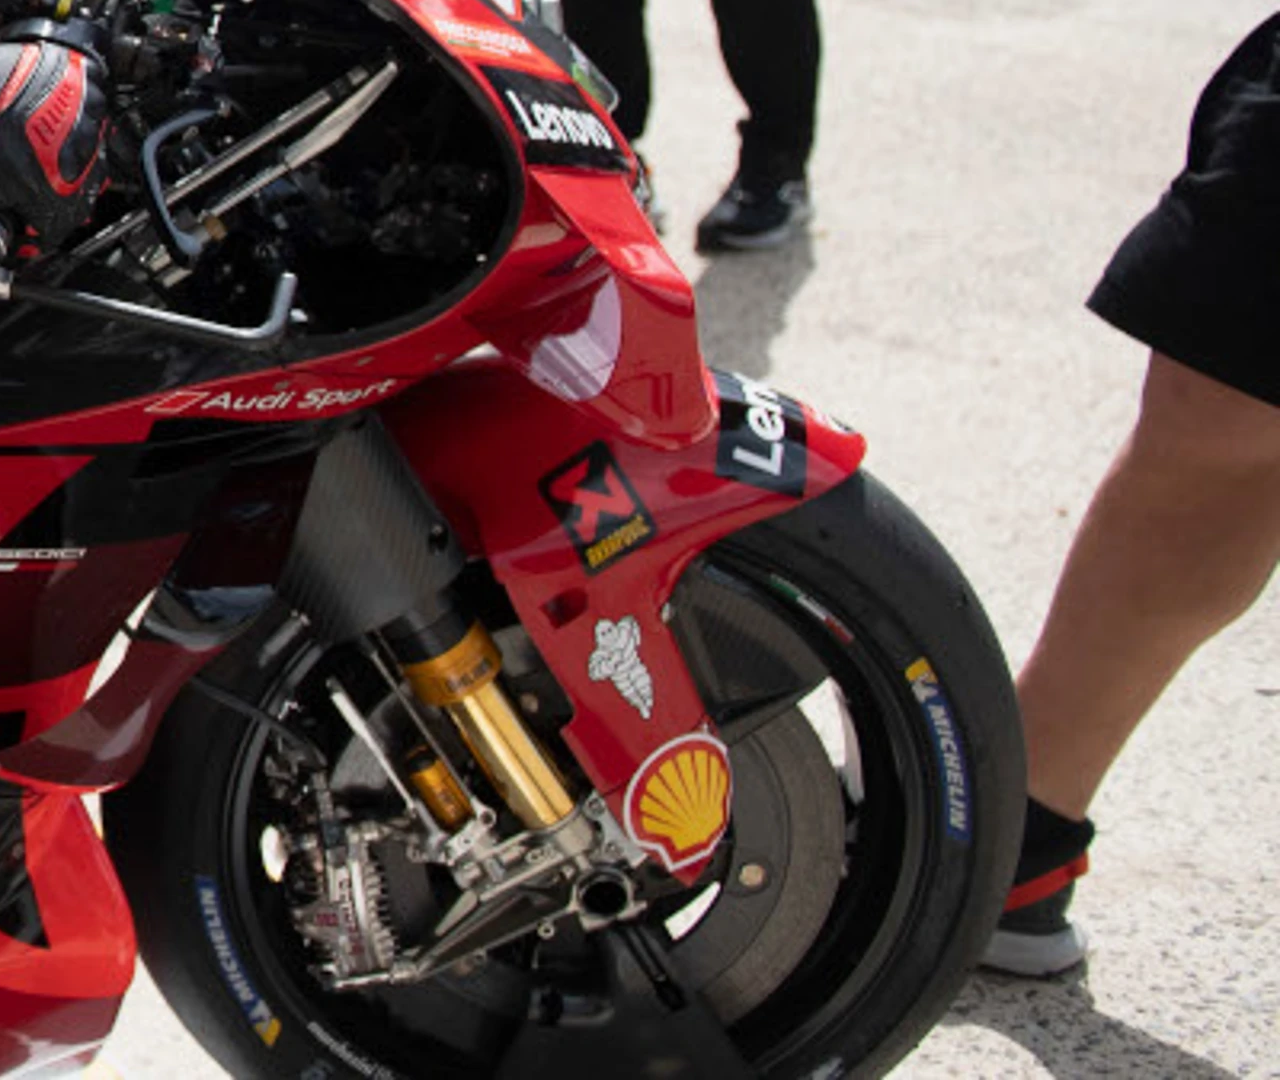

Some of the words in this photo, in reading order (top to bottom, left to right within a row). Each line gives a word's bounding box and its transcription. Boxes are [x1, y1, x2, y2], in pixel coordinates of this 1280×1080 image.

[505, 88, 615, 150] Lenovo
[207, 387, 295, 414] Audi
[300, 377, 397, 411] Sport
[926, 704, 967, 831] MICHELIN
